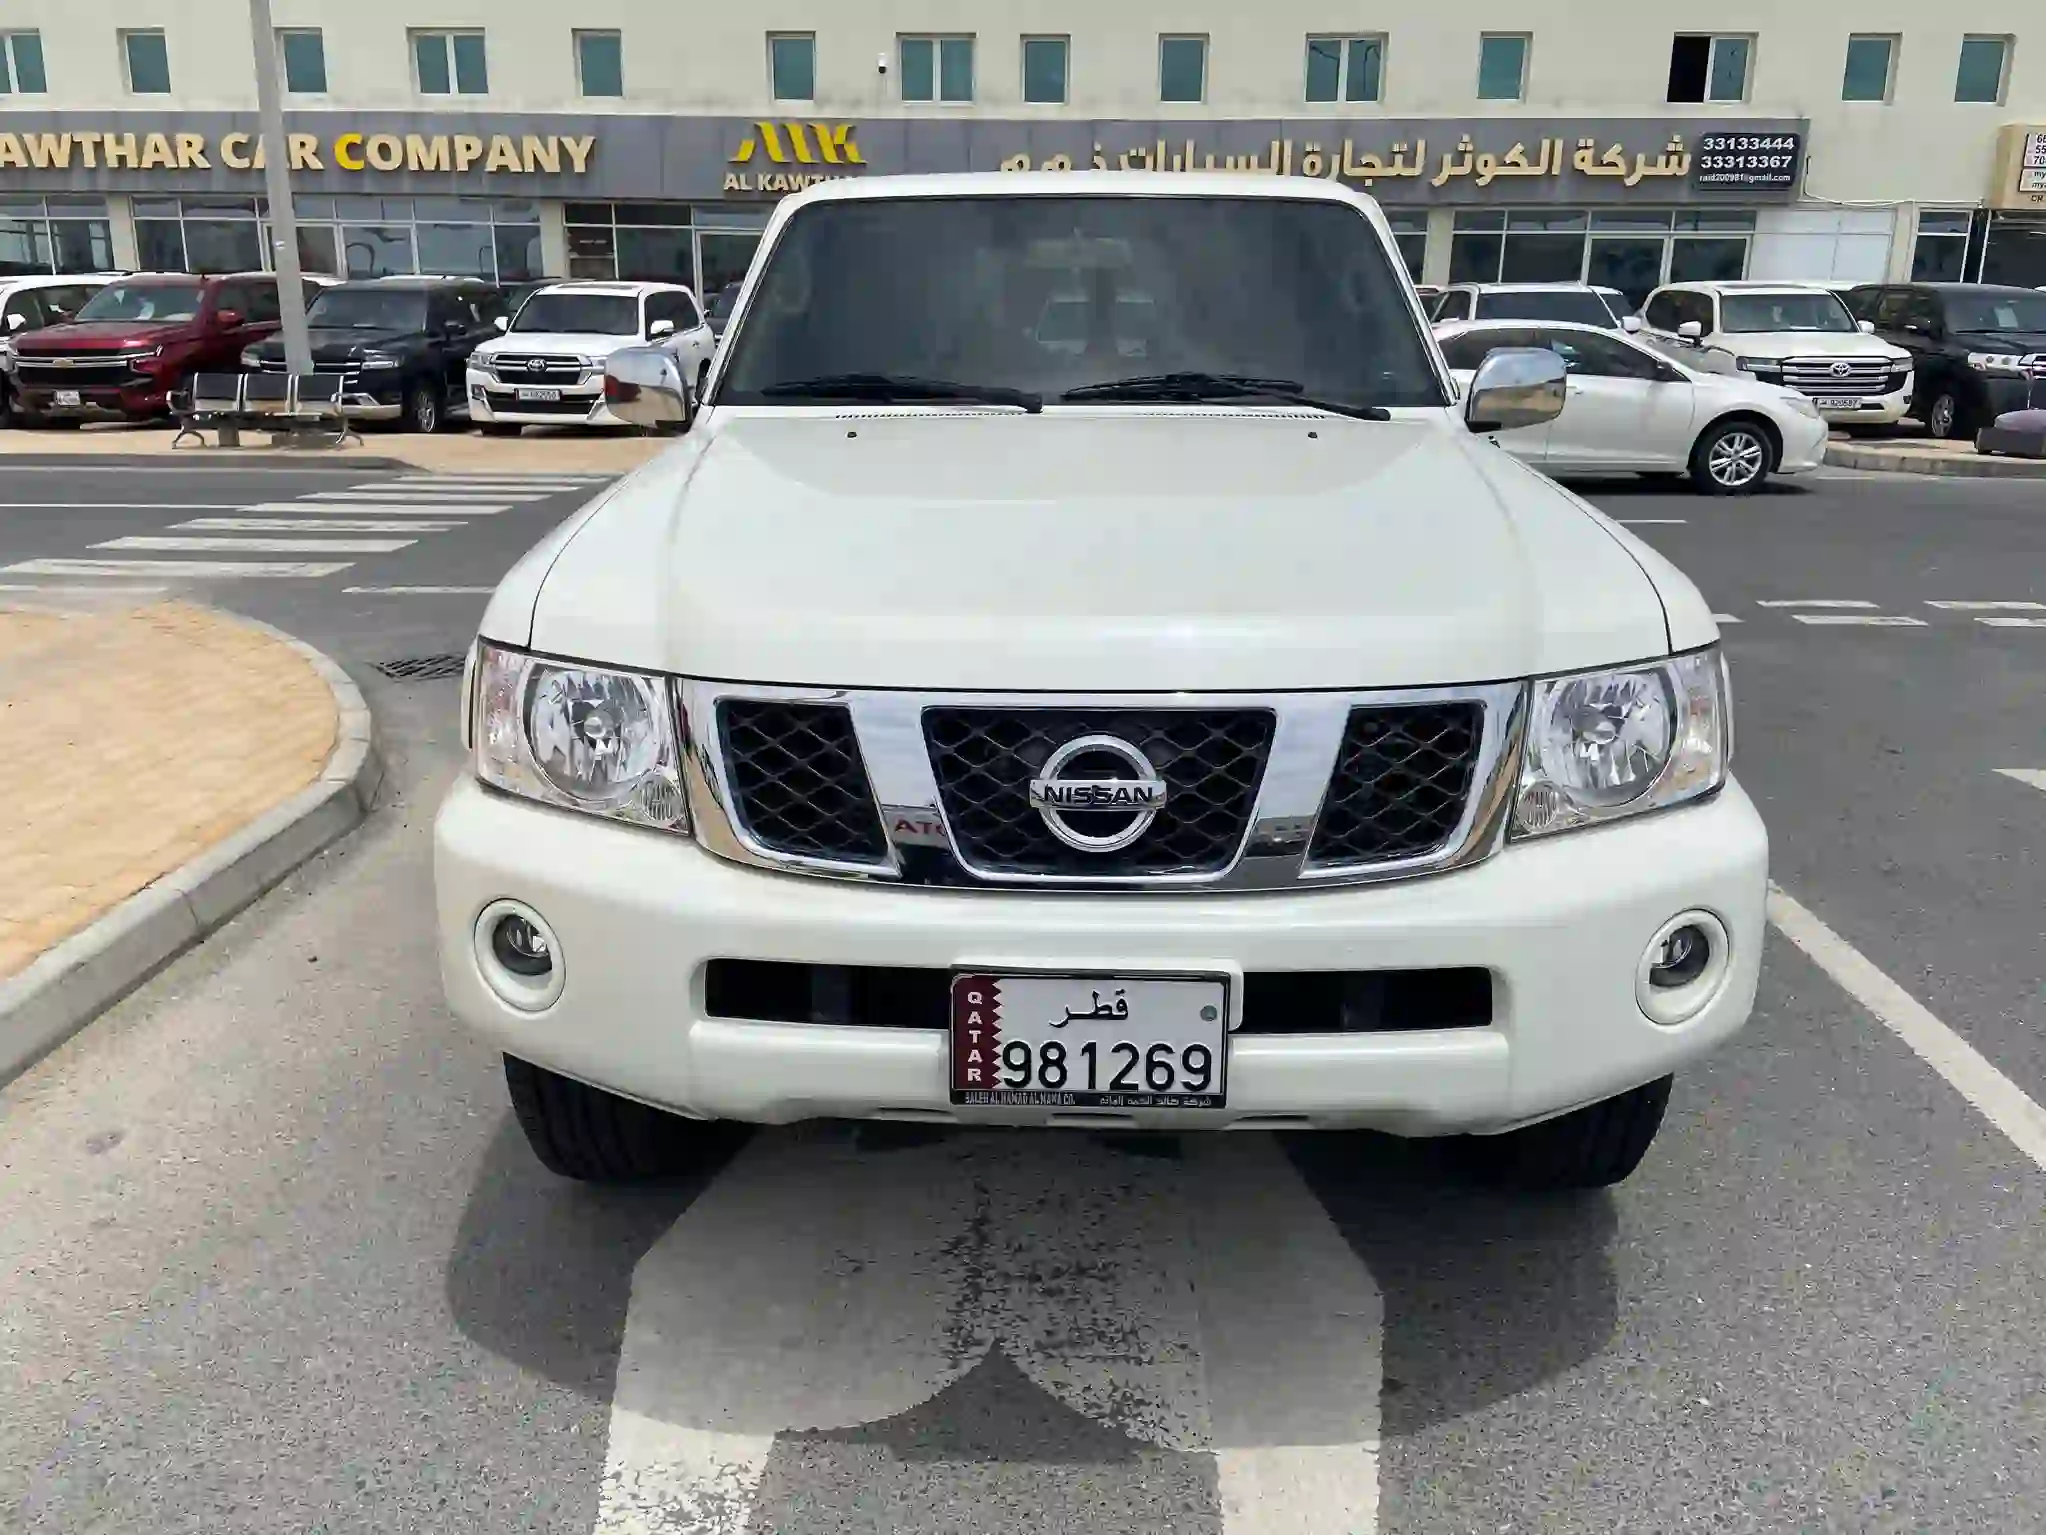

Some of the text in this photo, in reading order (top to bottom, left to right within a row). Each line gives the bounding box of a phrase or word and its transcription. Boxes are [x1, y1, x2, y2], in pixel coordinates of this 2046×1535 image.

[333, 133, 596, 173] COMPANY
[1302, 139, 1426, 187] لتجارة
[1431, 134, 1563, 187] الكوثر
[1573, 134, 1691, 186] شركة
[1700, 155, 1793, 169] 33313367
[1703, 137, 1794, 151] 33133444
[723, 172, 753, 191] AL
[1044, 786, 1153, 804] NISSAN
[1048, 988, 1129, 1028] قطر
[966, 991, 983, 1082] QATAR
[1002, 1040, 1212, 1092] 981269
